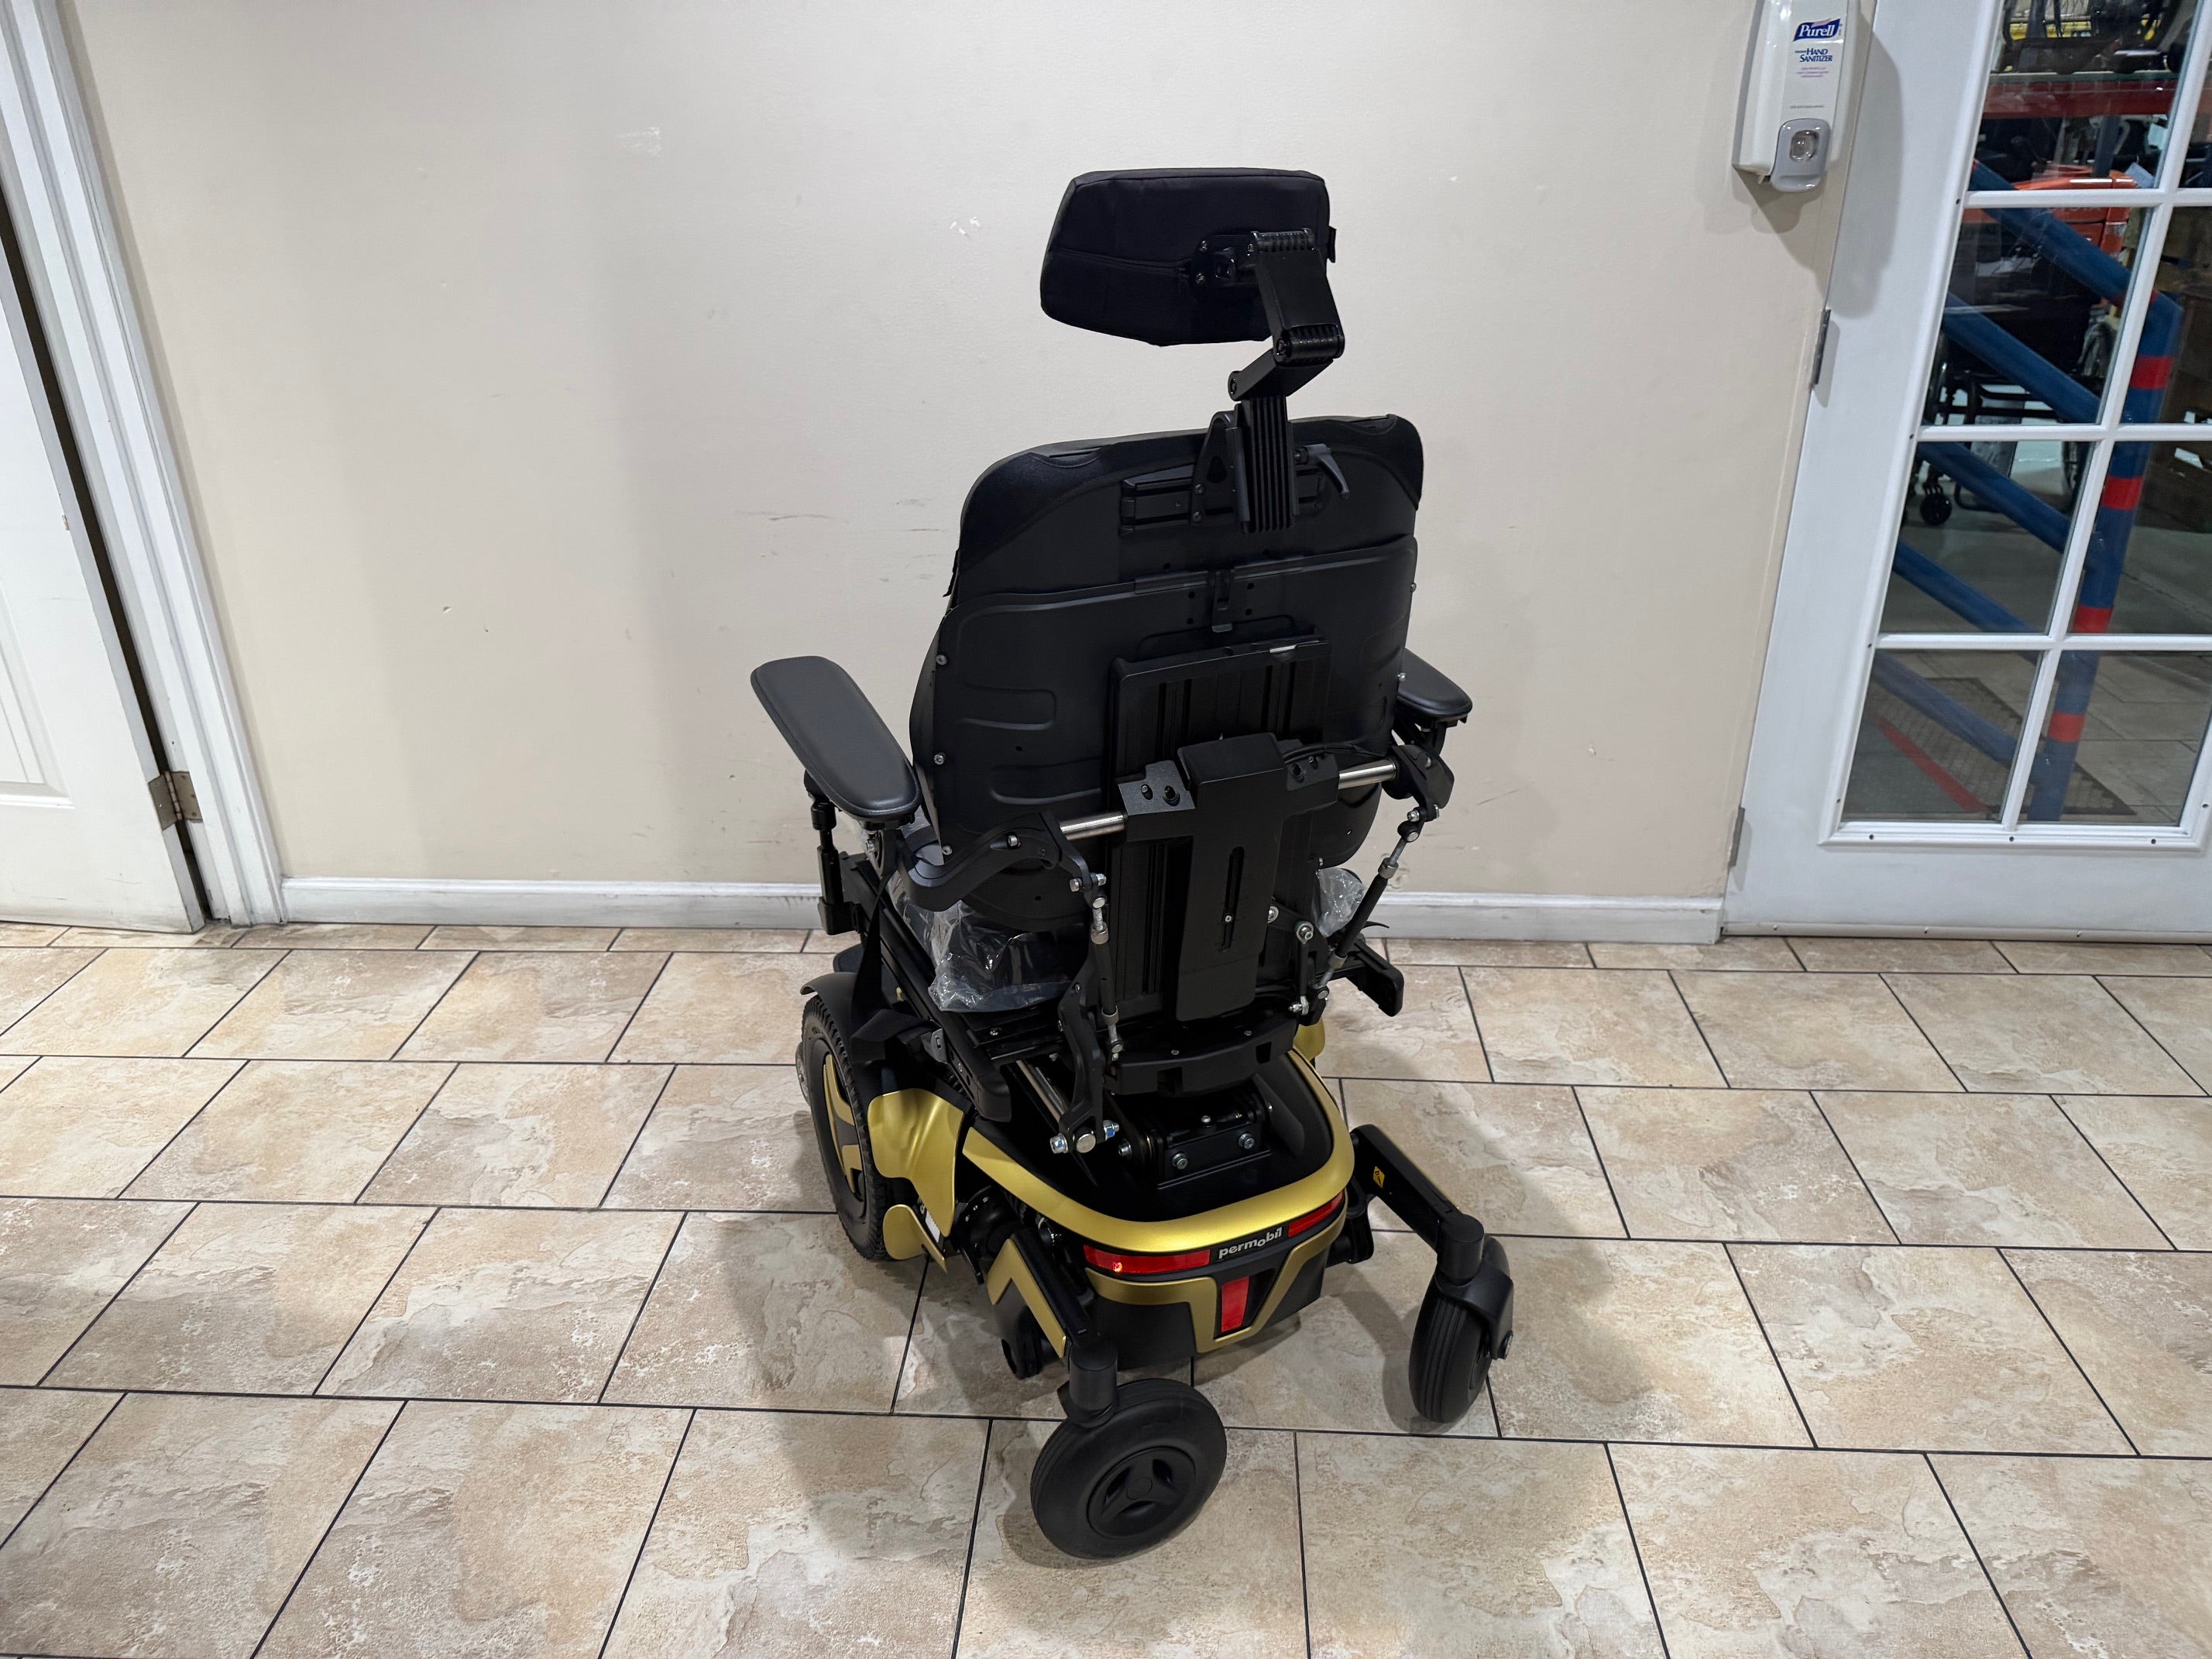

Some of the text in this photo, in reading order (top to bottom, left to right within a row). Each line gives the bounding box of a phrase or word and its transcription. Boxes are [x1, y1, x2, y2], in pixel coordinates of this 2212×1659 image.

[1798, 24, 1836, 37] Purell
[1806, 47, 1829, 56] HAND
[1218, 1227, 1283, 1259] permobil
